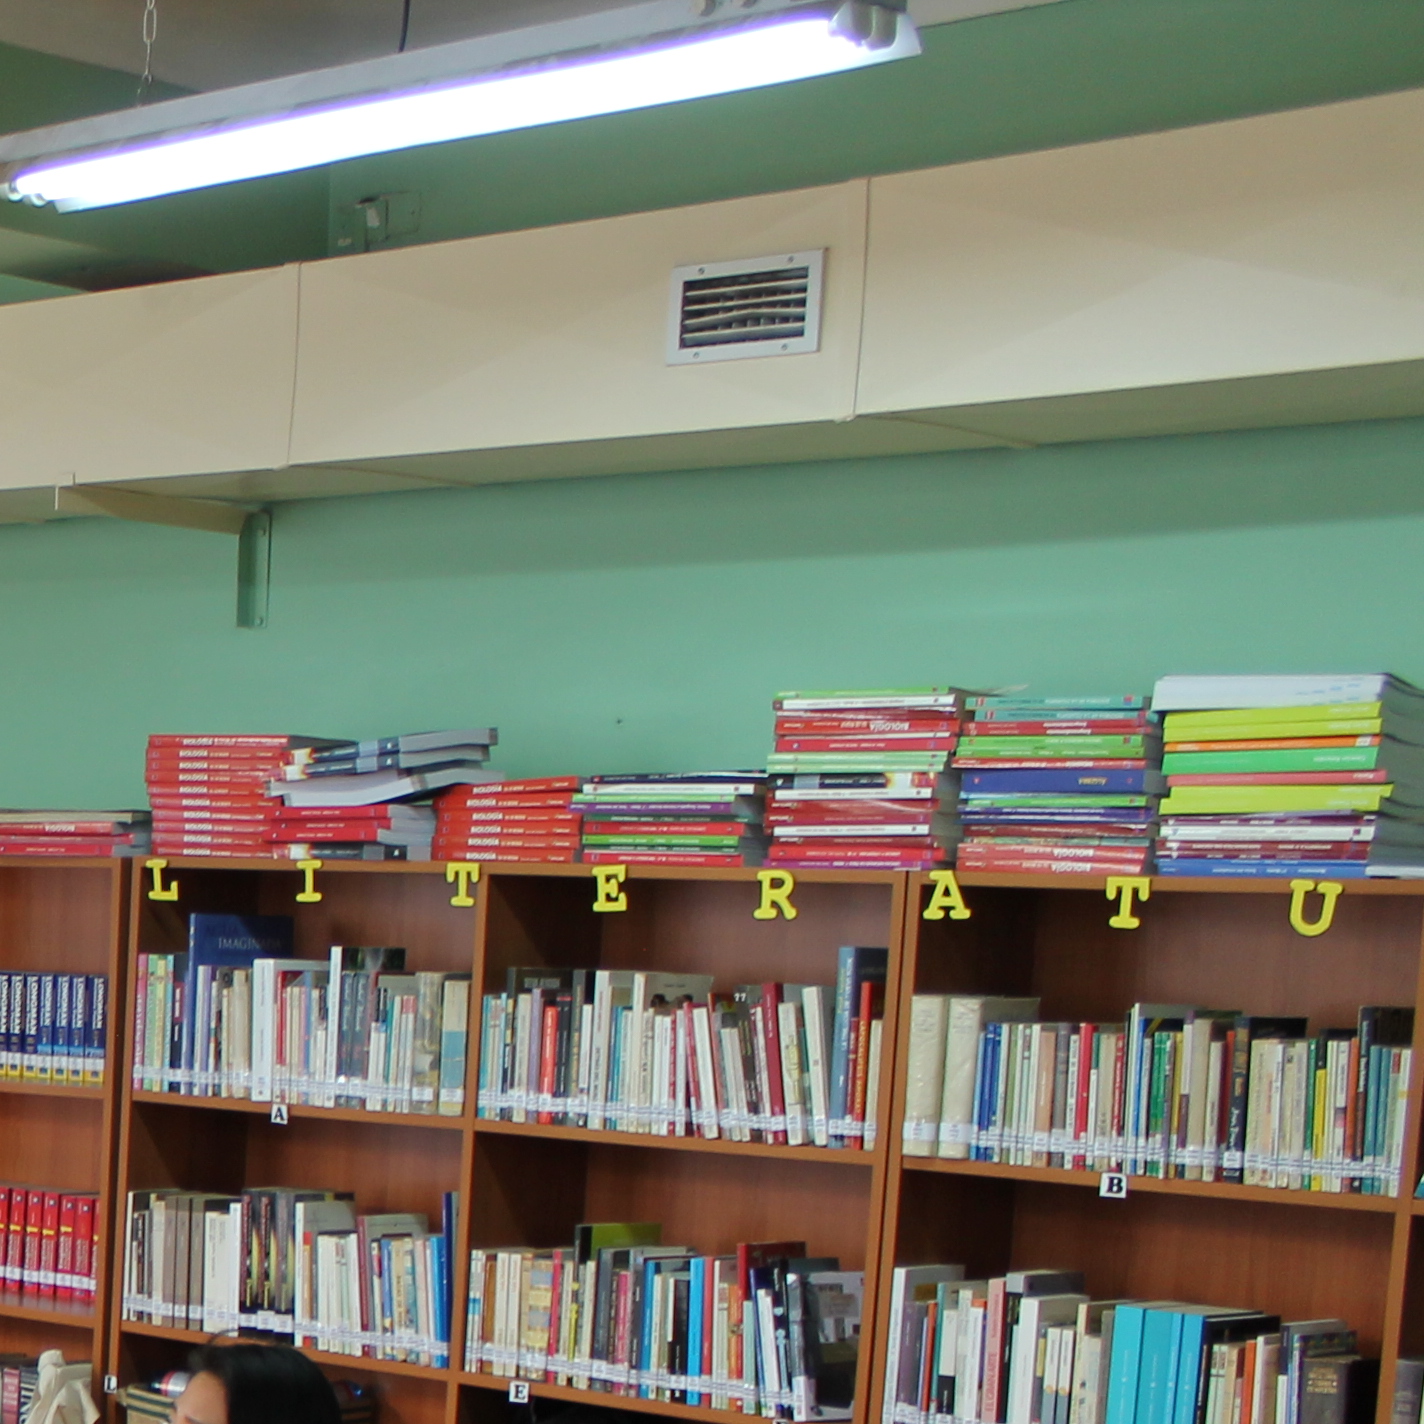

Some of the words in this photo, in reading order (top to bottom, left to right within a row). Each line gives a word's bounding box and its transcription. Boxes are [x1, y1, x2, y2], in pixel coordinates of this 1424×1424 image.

[0, 975, 8, 1033] LONGMAN
[14, 975, 23, 1034] LONGMAN
[30, 976, 38, 1035] LONGMAN
[44, 975, 52, 1026] LONGMAN
[60, 975, 68, 1027] LONGMAN
[76, 977, 84, 1028] LONGMAN
[96, 978, 104, 1029] LONGMAN
[272, 1105, 287, 1121] A
[1106, 1177, 1124, 1196] B
[106, 1376, 116, 1392] L
[512, 1383, 527, 1400] E
